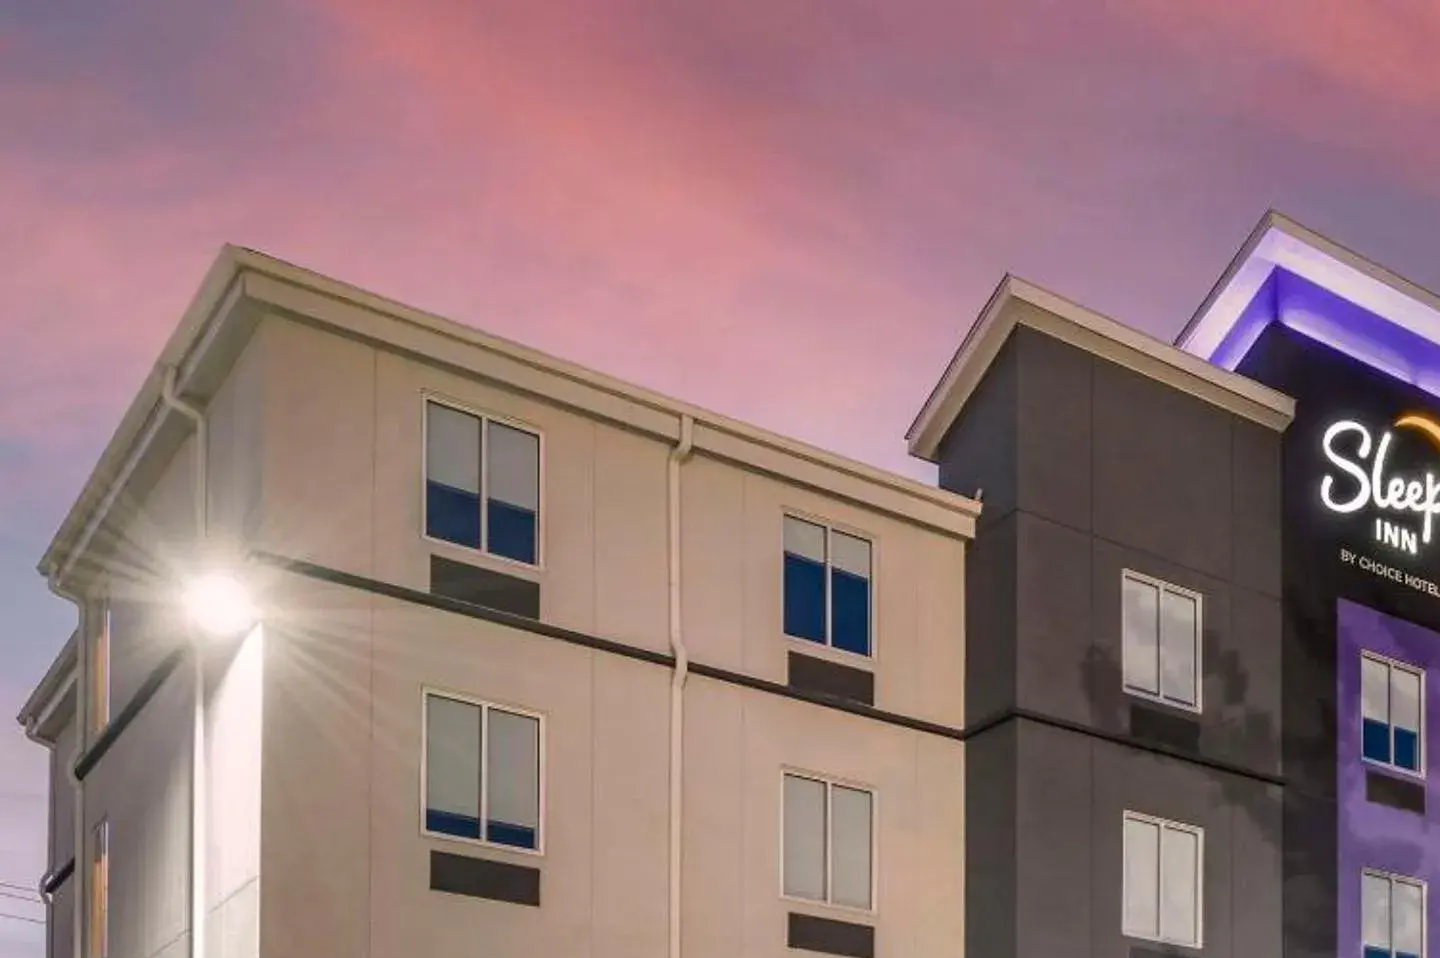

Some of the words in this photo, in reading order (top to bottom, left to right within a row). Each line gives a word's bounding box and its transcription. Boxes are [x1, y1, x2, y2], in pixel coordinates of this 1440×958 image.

[1375, 517, 1418, 554] INN
[1341, 548, 1356, 566] BY
[1358, 556, 1402, 583] CHOICE
